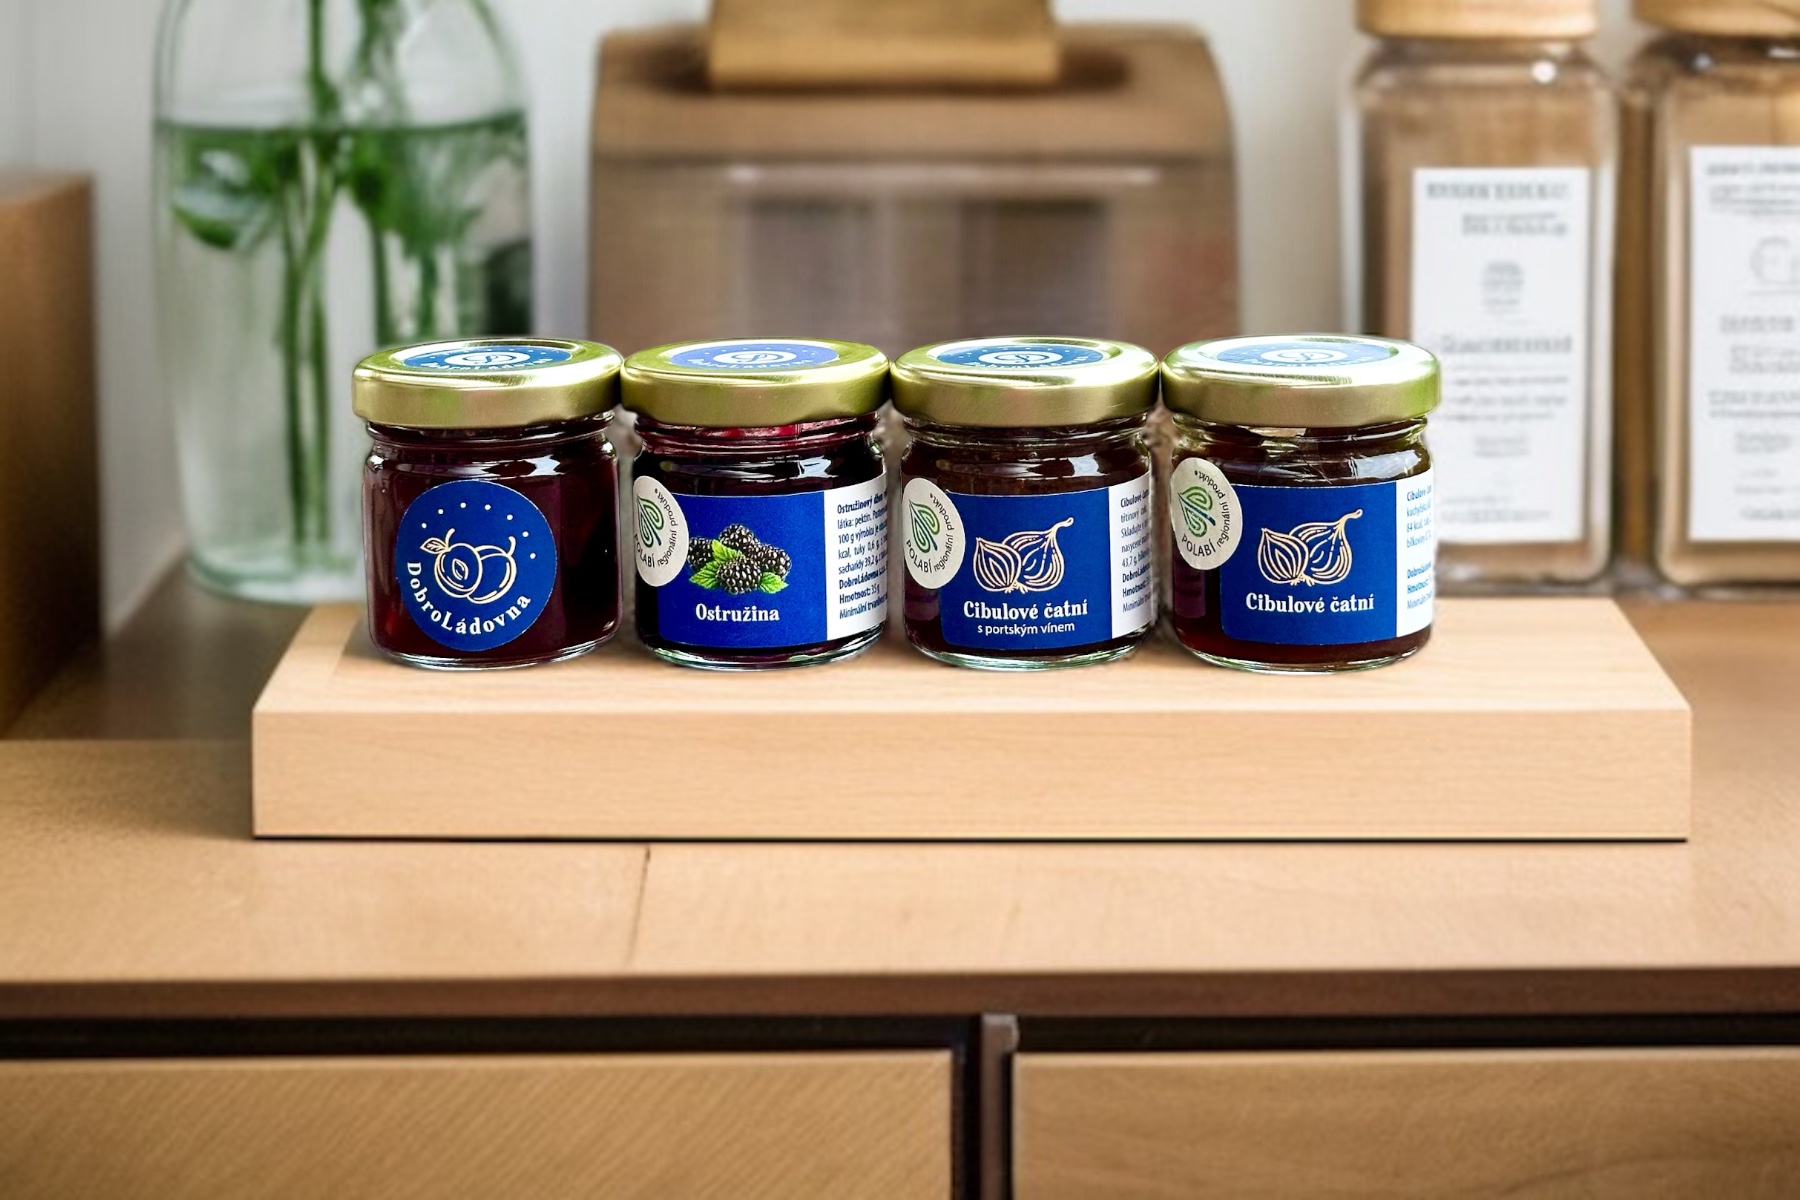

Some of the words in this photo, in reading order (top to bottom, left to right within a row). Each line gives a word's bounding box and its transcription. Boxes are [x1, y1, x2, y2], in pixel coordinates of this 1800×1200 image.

[838, 533, 850, 544] 100
[1182, 533, 1217, 557] POLABÍ
[1216, 501, 1231, 548] regionální
[634, 533, 655, 568] POLABÍ
[657, 529, 678, 567] regionální
[906, 539, 933, 574] POLABÍ
[934, 533, 954, 572] regionální
[407, 562, 531, 635] DobroLádovna
[1245, 592, 1325, 613] Cibulové
[1330, 593, 1375, 612] čatní
[695, 603, 780, 622] Ostružina
[963, 600, 1039, 620] Cibulové
[1043, 599, 1088, 619] čatní
[977, 625, 983, 633] s
[985, 623, 1038, 638] portským
[1040, 622, 1075, 634] vínem
